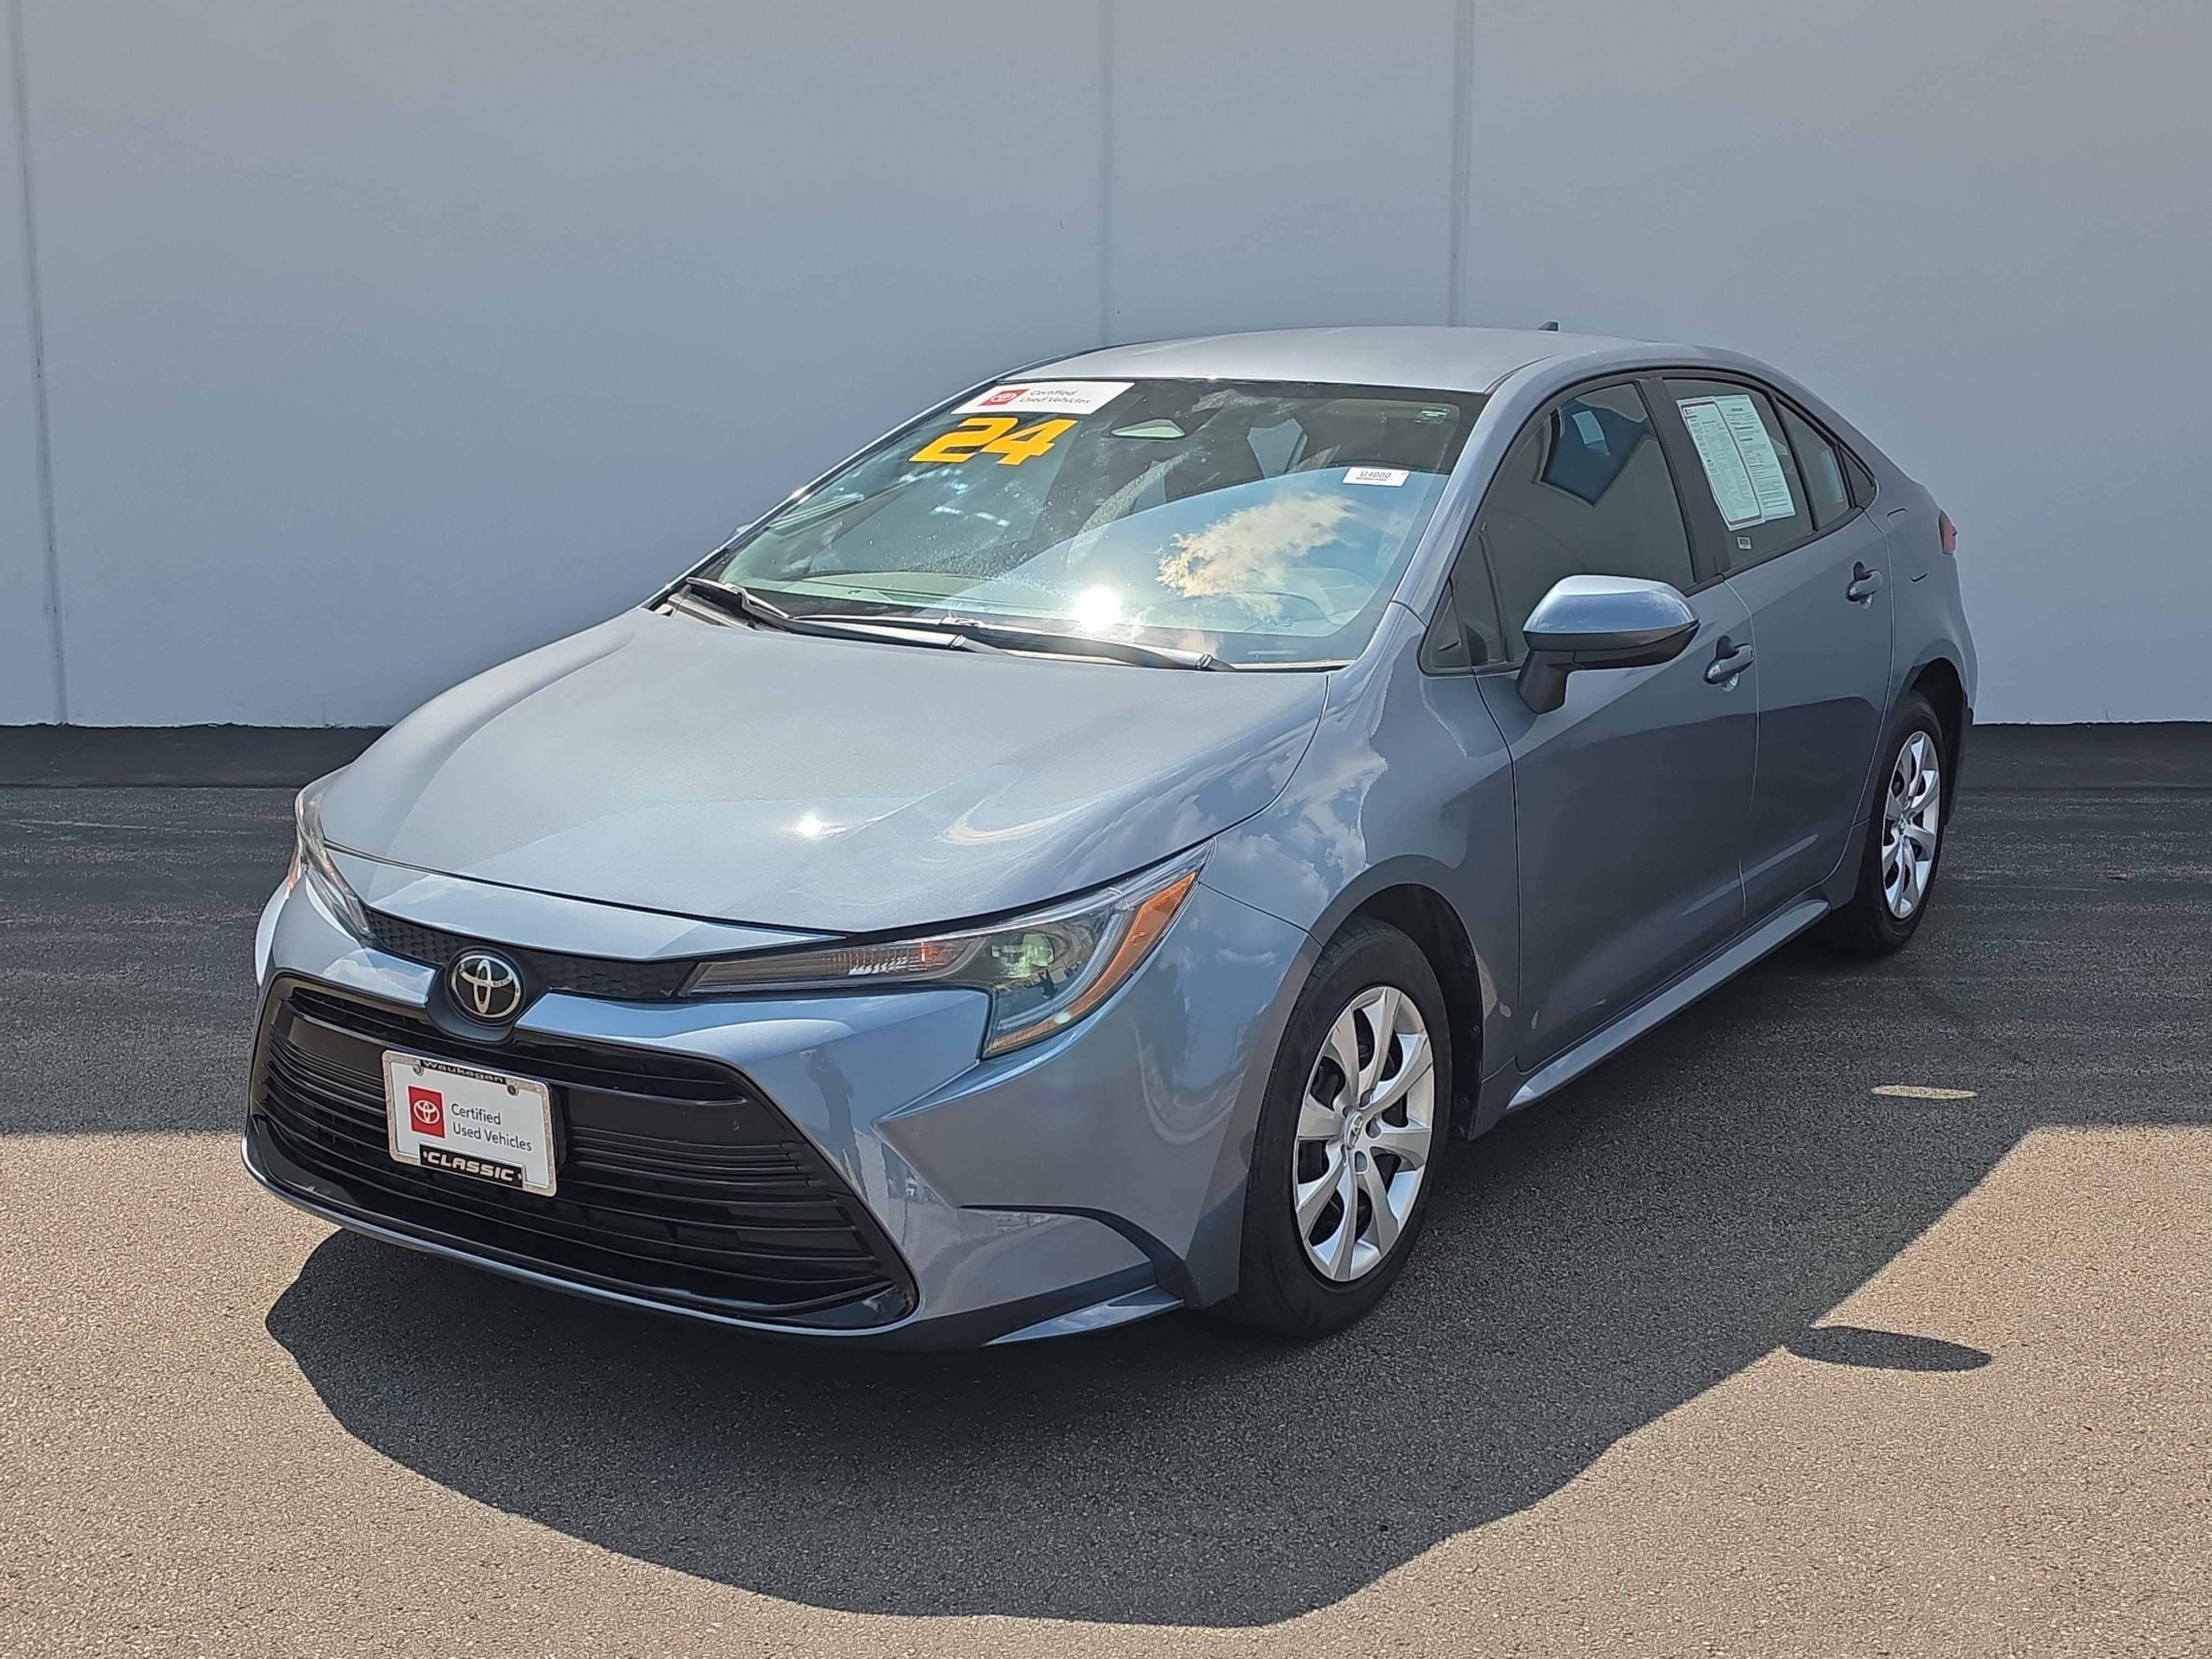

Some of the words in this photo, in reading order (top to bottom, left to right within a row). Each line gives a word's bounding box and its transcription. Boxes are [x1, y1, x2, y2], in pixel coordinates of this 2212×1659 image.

[909, 416, 1078, 465] 24
[422, 1060, 504, 1083] Waukegan
[451, 1103, 501, 1126] Certified
[453, 1121, 481, 1140] Used
[484, 1129, 532, 1152] Vehicles
[427, 1151, 515, 1181] CLASSIC
